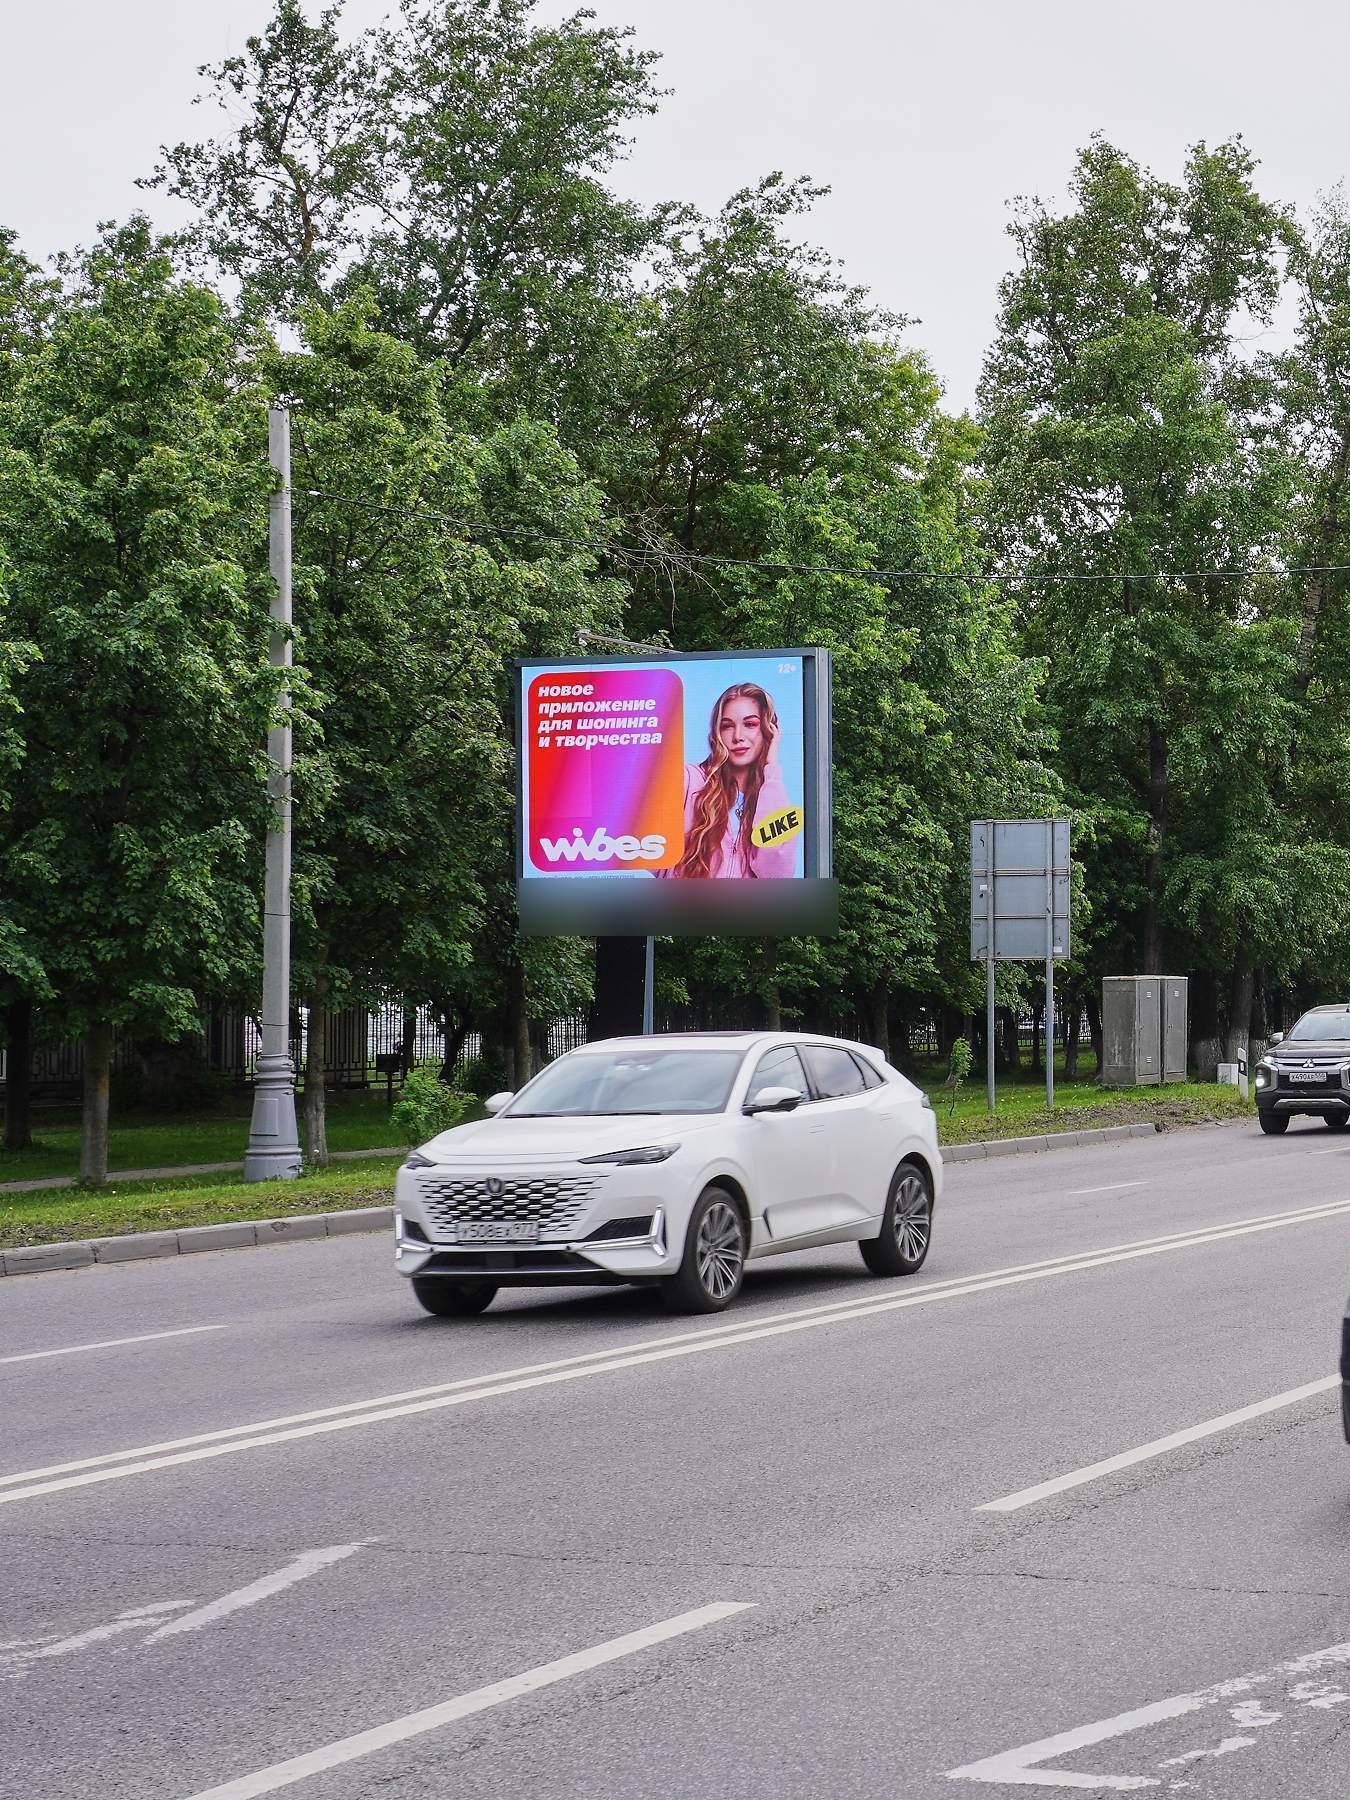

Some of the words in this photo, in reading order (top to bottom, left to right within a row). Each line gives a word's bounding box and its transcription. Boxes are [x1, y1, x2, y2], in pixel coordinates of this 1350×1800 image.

[538, 684, 594, 697] новое
[538, 699, 656, 718] приложение
[538, 719, 573, 734] для
[577, 716, 658, 730] шопинга
[538, 736, 550, 748] и
[555, 732, 663, 751] творчества
[759, 810, 799, 844] LIKE
[539, 827, 667, 861] wibes
